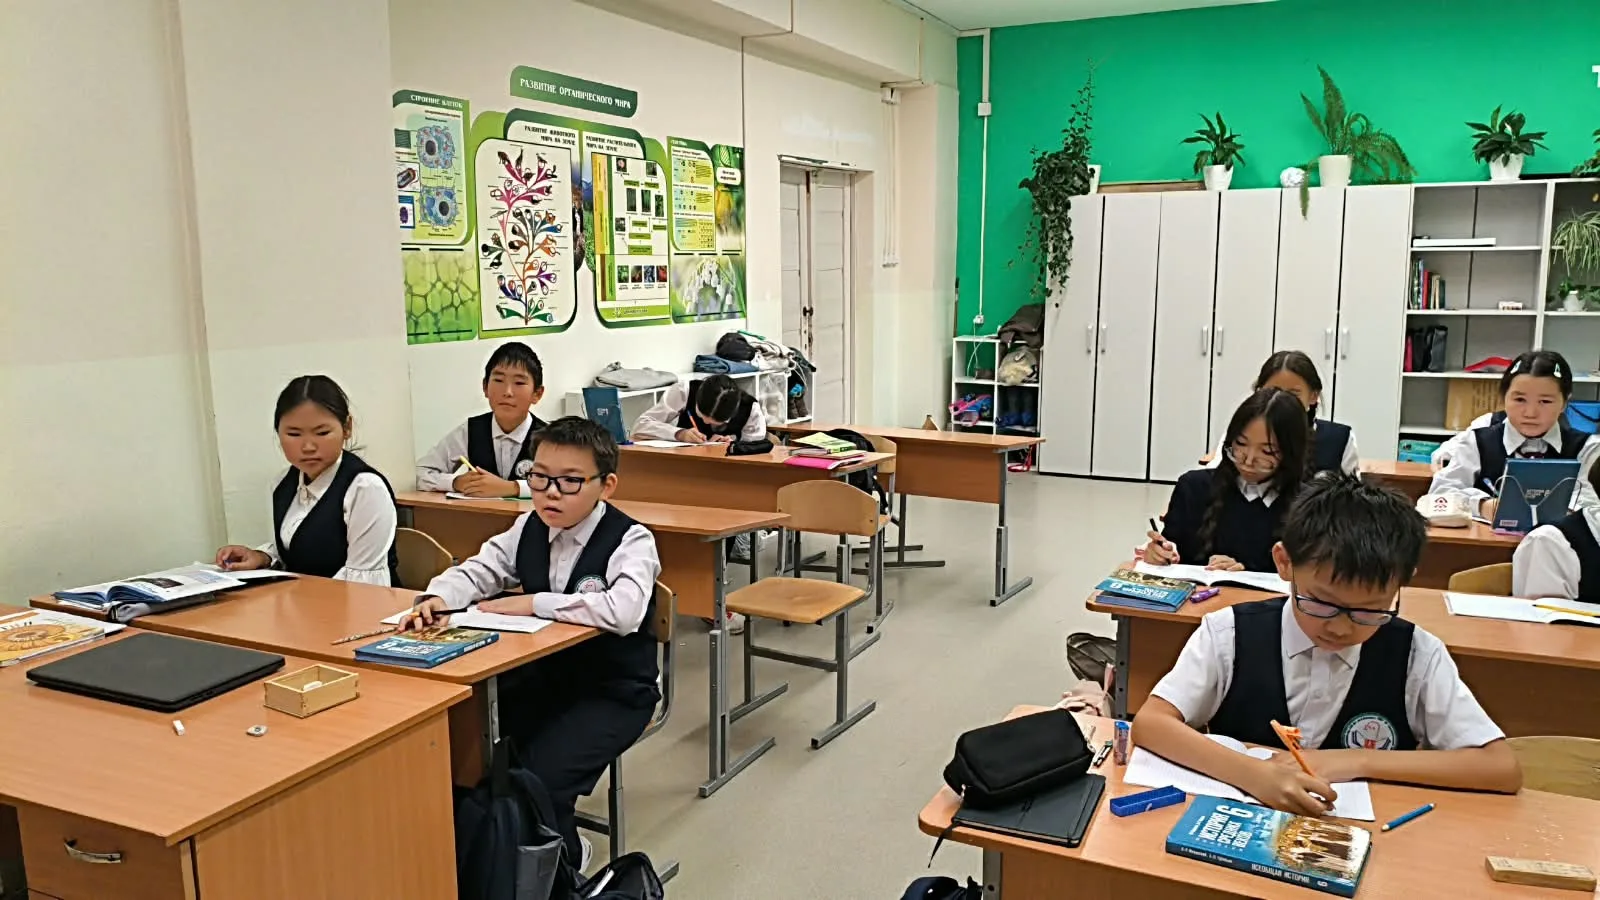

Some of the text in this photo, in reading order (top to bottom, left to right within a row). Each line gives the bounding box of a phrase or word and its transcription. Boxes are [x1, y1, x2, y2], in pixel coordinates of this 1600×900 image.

[410, 94, 441, 105] СТРОЕНИЕ
[520, 78, 631, 109] РАЗВИТИЕ ОРГАНИЧЕСКОГО МИРА
[524, 125, 576, 139] РАЗВИТИЕ ЖИВОТНОГО
[540, 135, 553, 143] МИРА
[585, 135, 606, 144] РАЗВИТИЕ
[1215, 804, 1254, 819] 6
[1198, 812, 1230, 842] ИСТОРИЯ
[1217, 820, 1244, 845] СРЕДНИХ
[1232, 830, 1253, 848] ВЕКОВ
[1251, 863, 1283, 879] ВСЕОБЩАЯ
[1283, 870, 1310, 884] ИСТОРИЯ
